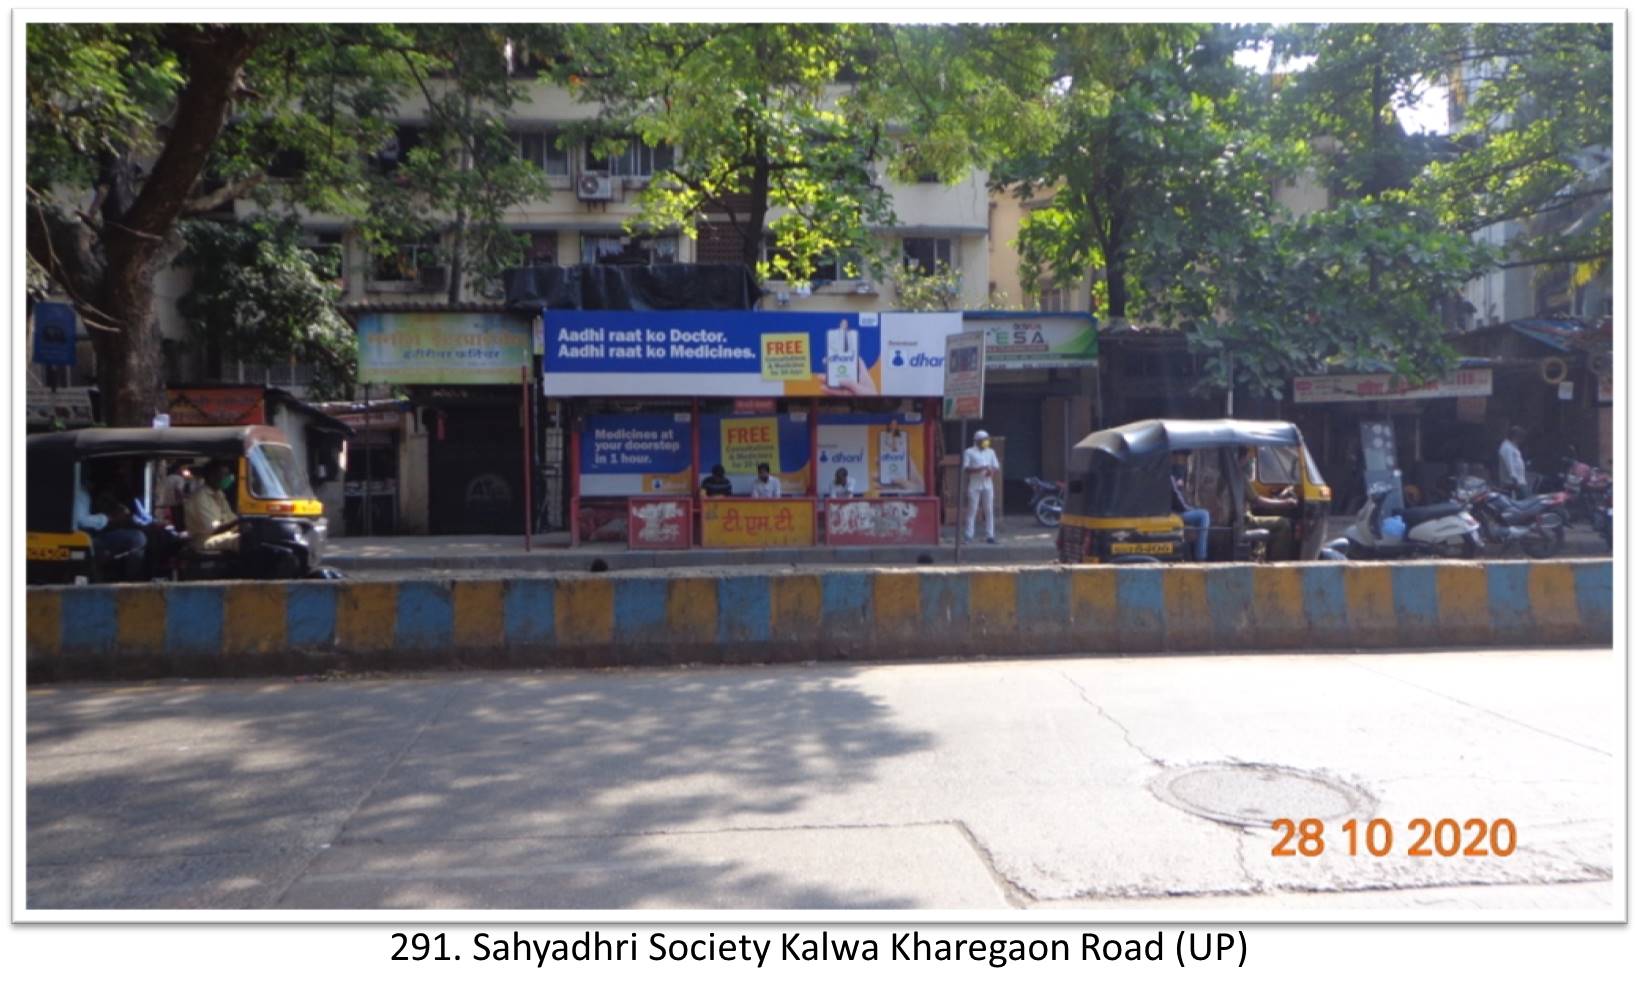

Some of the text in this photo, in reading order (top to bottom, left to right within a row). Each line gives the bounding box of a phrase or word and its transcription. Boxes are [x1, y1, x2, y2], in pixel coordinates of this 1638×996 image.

[558, 328, 727, 343] Aadhi raat ko Doctor.
[558, 344, 756, 359] Aadhi raat ko Medicines.
[766, 341, 803, 355] FREE
[595, 429, 674, 440] Medicines at
[727, 426, 770, 445] FREE
[595, 441, 680, 453] your doorstep
[595, 453, 652, 464] in 1 hour.
[832, 447, 864, 464] dhani
